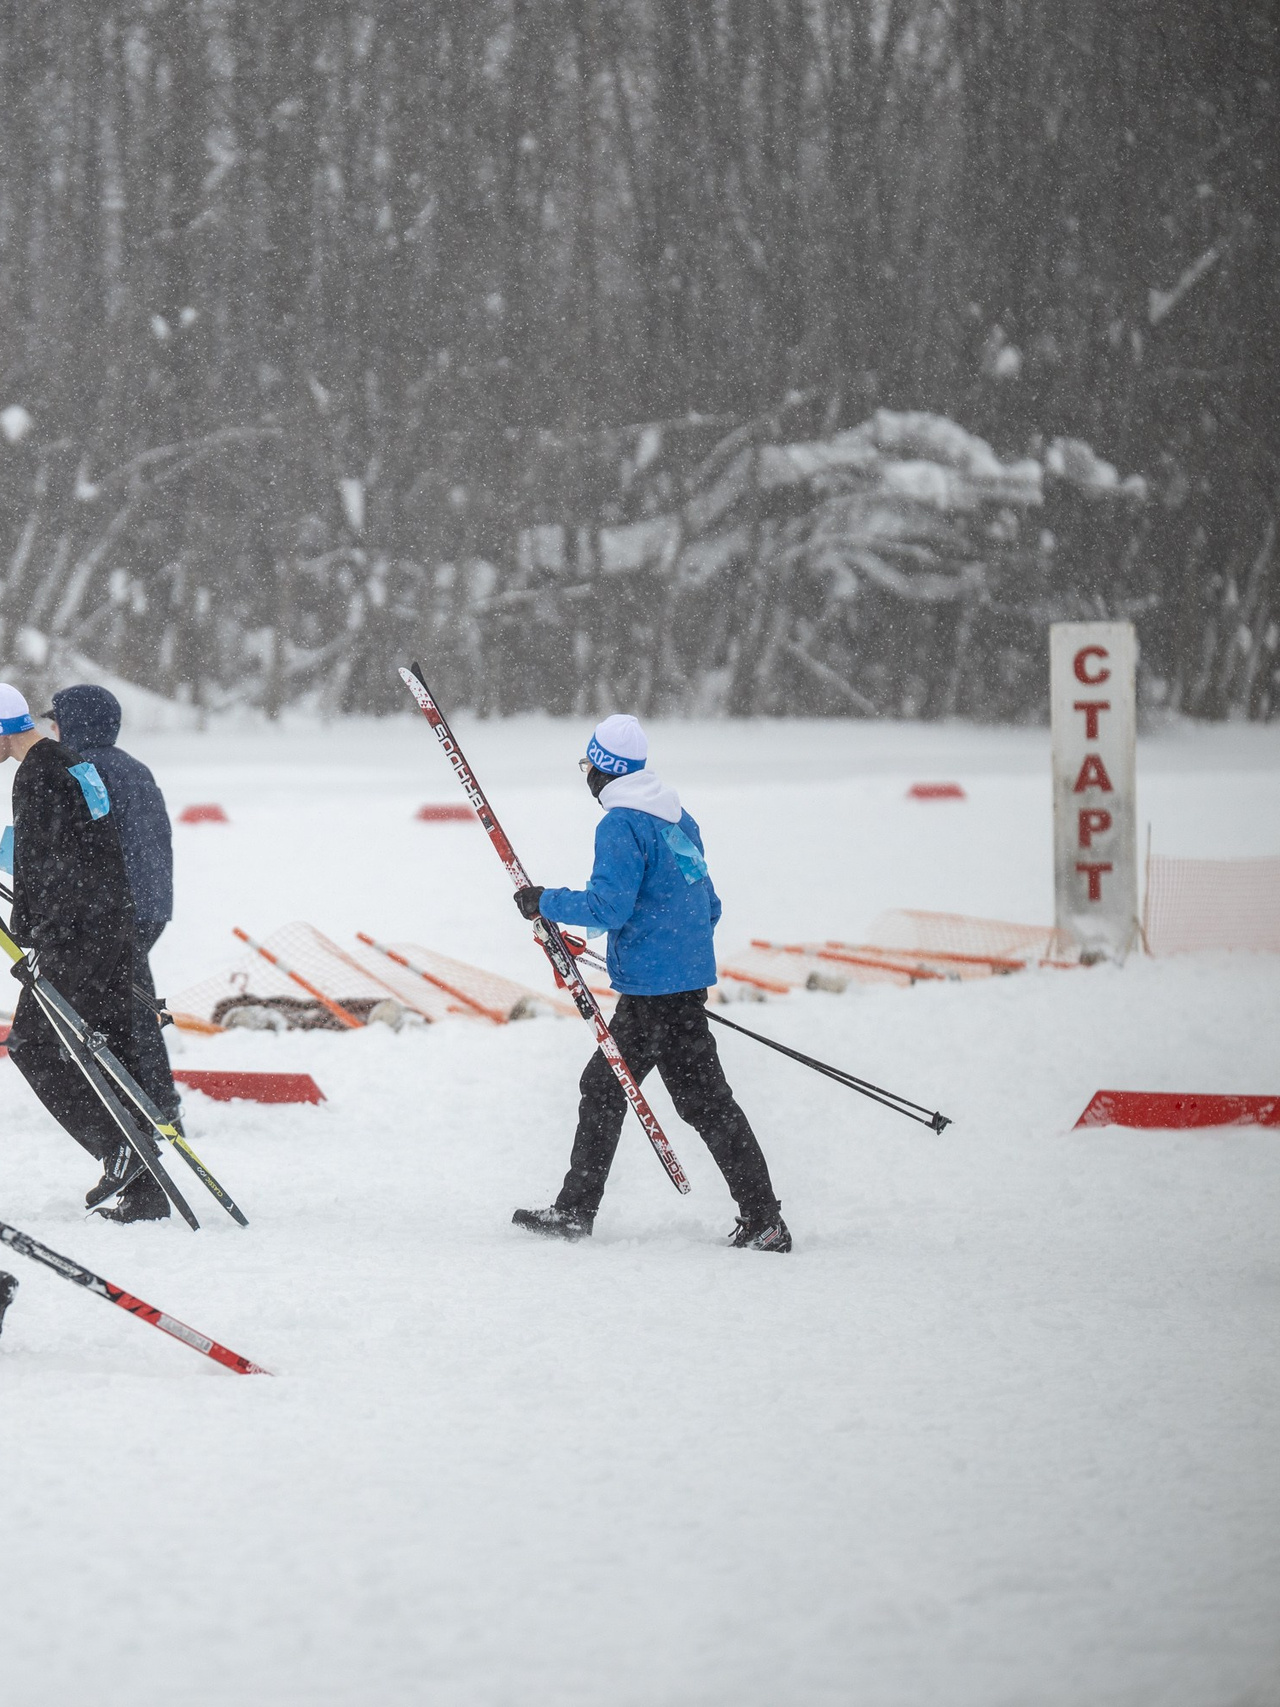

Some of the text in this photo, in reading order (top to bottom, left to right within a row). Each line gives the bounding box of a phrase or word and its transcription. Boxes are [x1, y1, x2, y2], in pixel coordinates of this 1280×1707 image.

[433, 723, 484, 810] BRADOS
[588, 742, 629, 774] 2026
[1072, 644, 1114, 902] СТАРТ
[613, 1062, 659, 1136] XT TOUR
[204, 1176, 223, 1197] CLASSIC
[663, 1151, 686, 1184] 205
